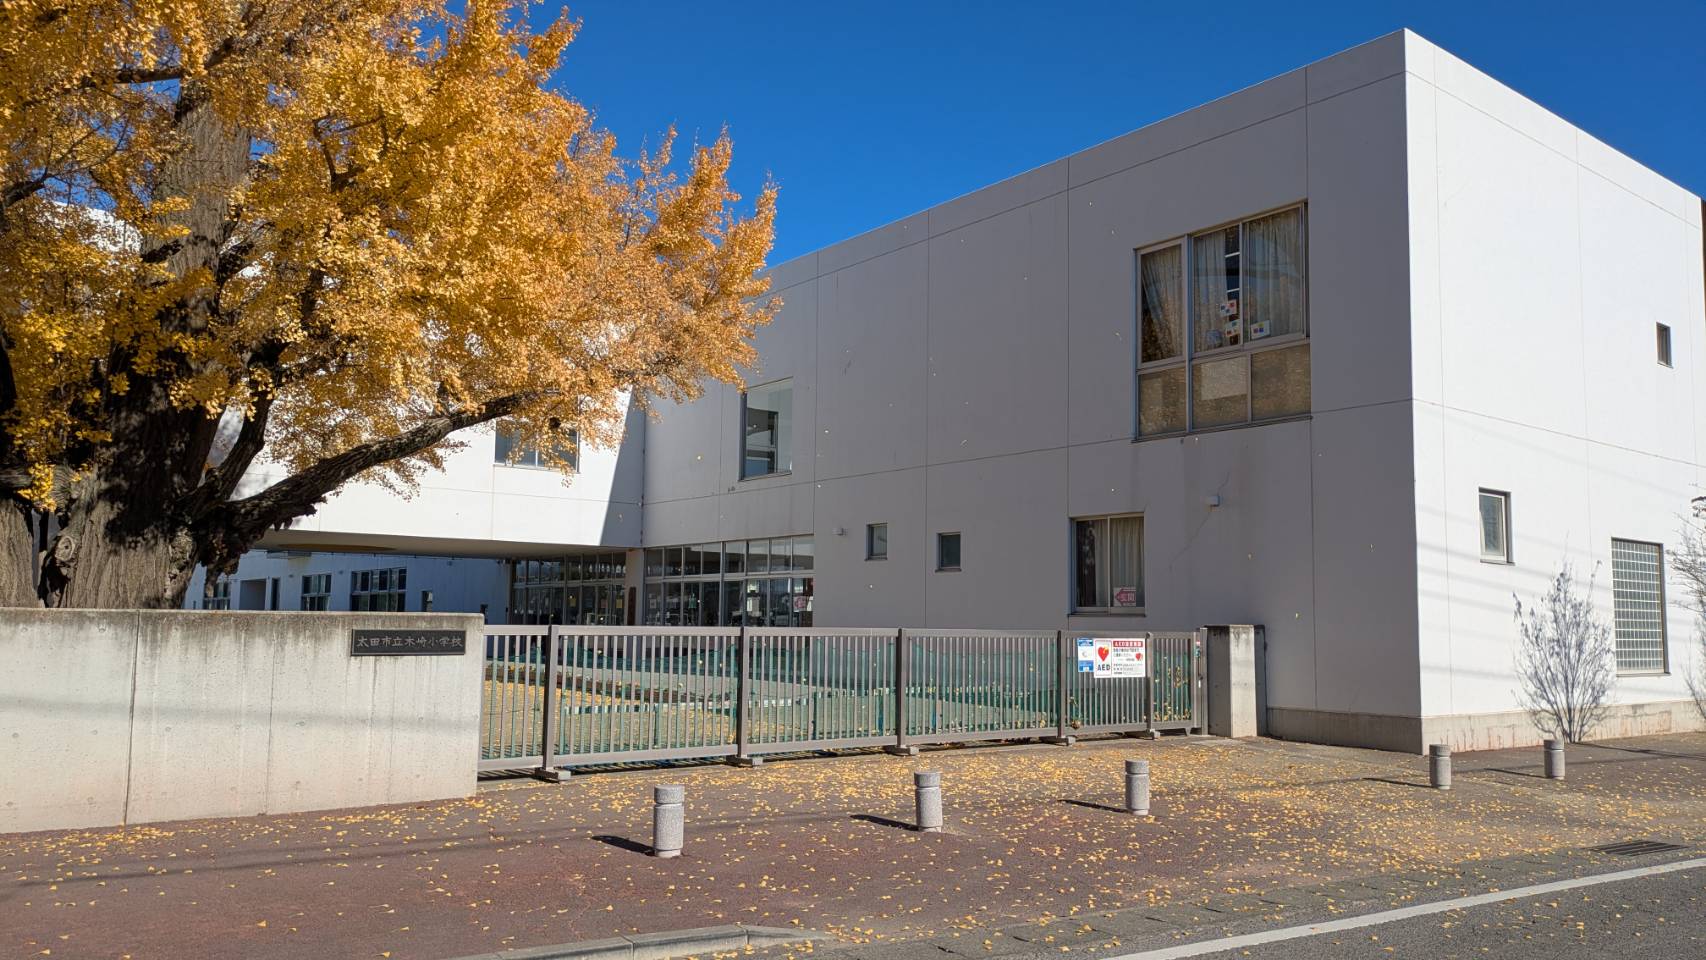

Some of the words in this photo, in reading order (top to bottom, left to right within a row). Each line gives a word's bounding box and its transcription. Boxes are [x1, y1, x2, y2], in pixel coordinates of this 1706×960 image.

[356, 636, 463, 648] 太田市立木崎小学校
